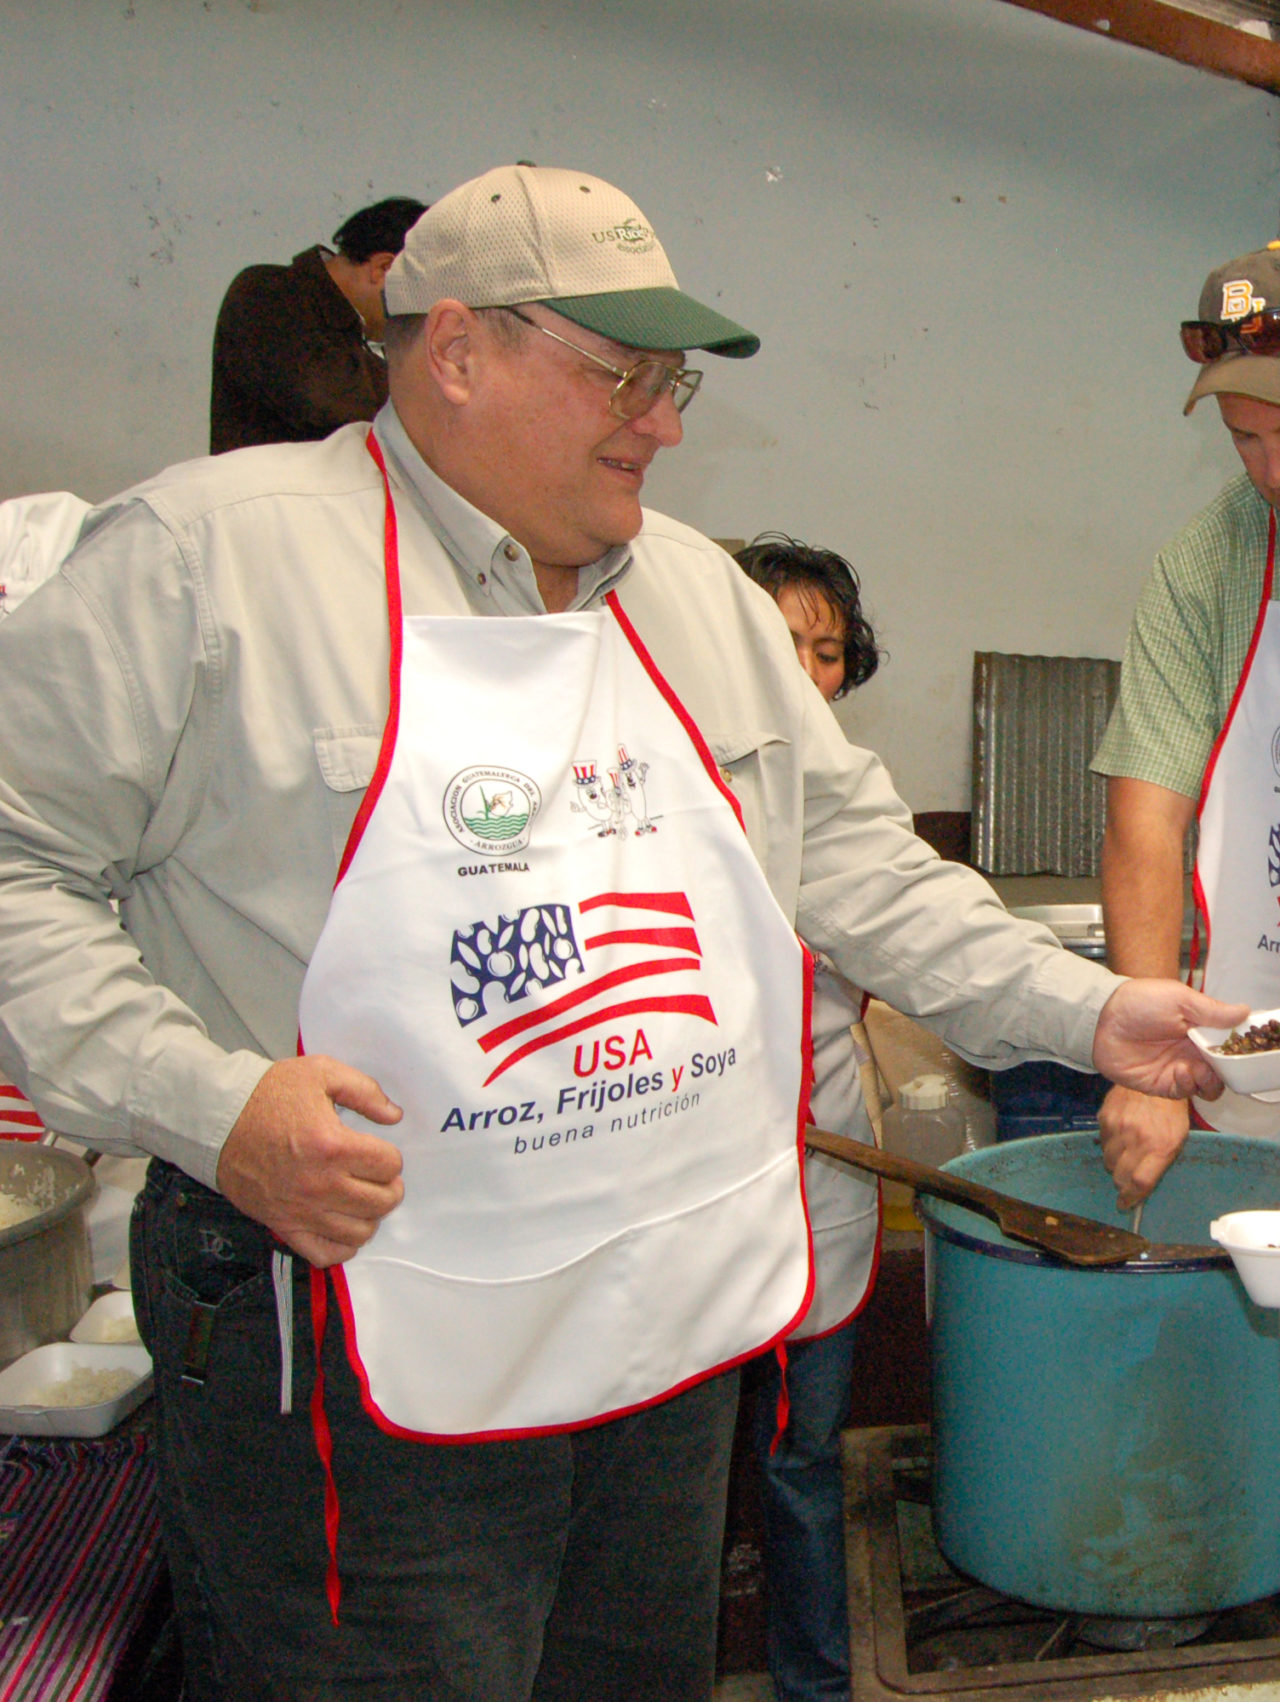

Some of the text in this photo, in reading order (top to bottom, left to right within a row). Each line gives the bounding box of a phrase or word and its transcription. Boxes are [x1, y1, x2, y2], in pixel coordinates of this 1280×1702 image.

[457, 862, 530, 877] GUATEMALA
[573, 1028, 653, 1078] USA
[440, 1047, 737, 1133] Arroz, Frijoles y Soya
[514, 1091, 701, 1155] buena nutrición
